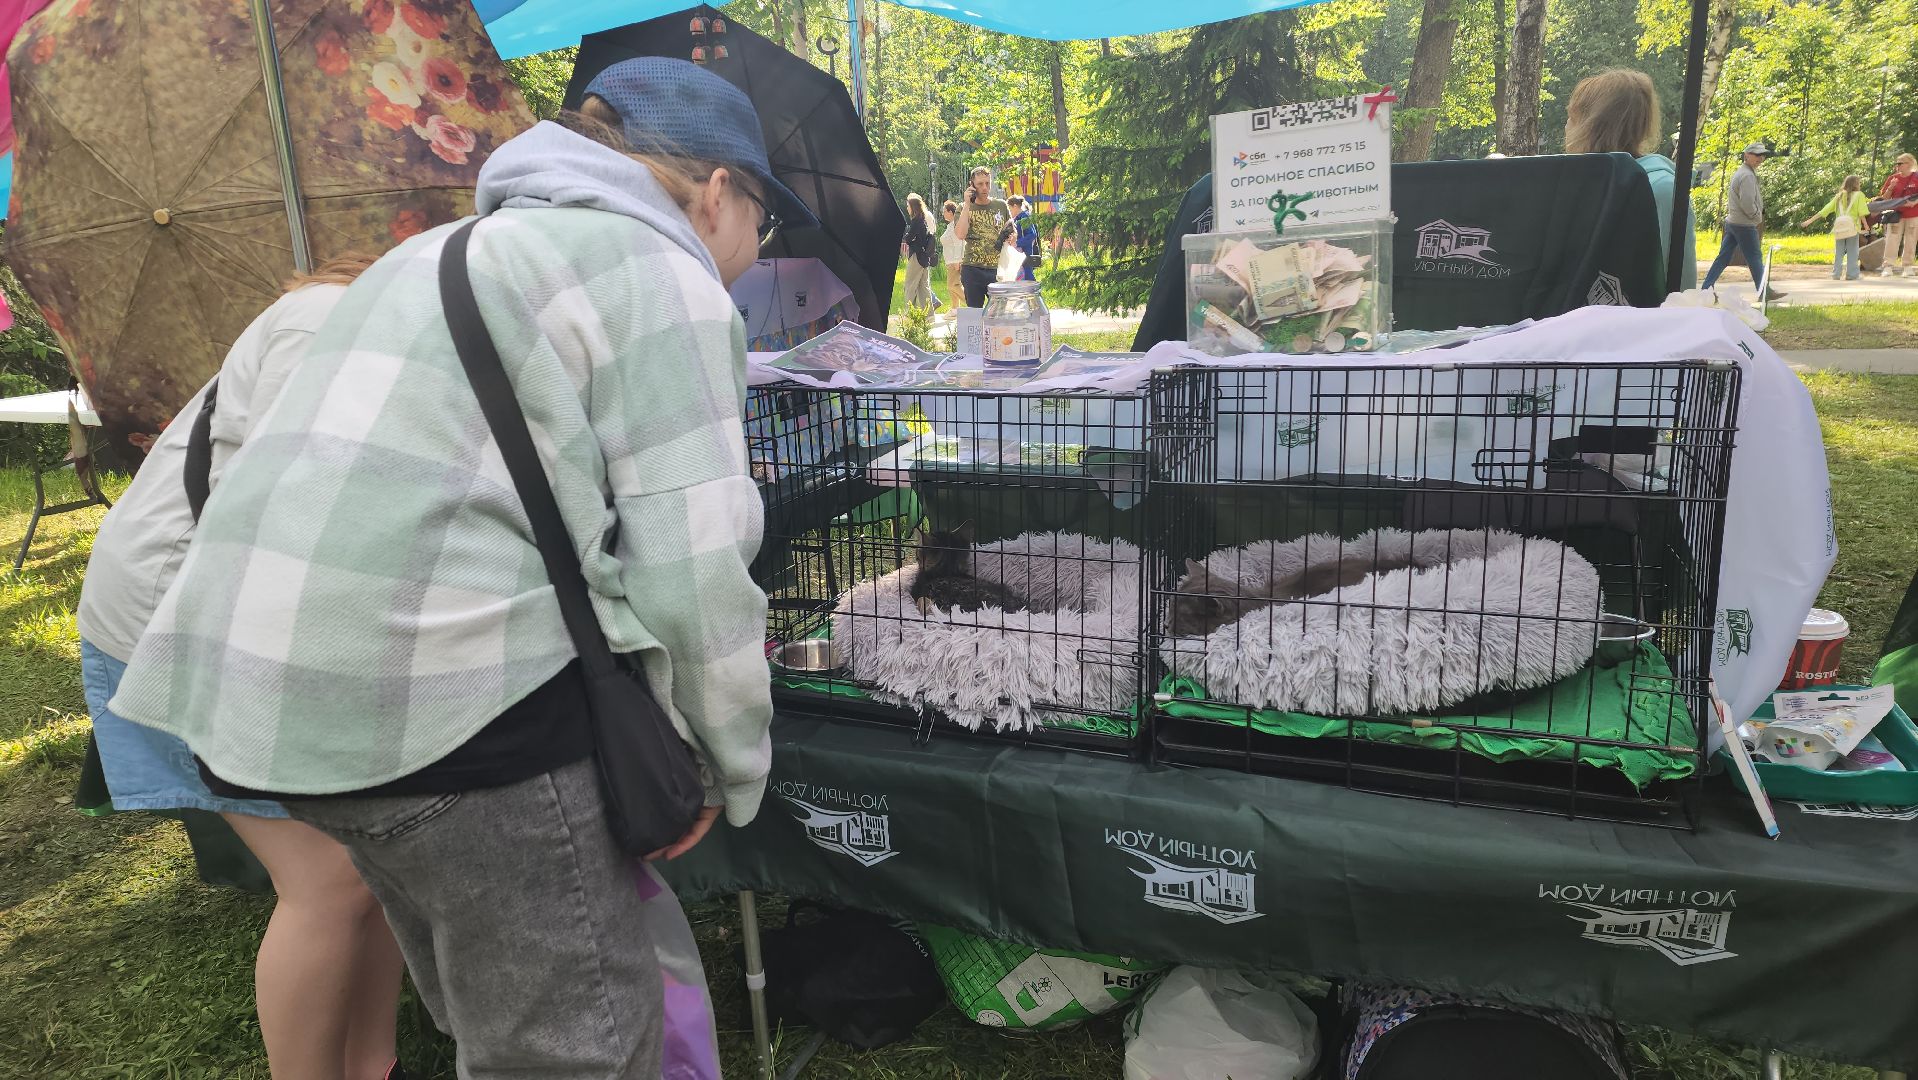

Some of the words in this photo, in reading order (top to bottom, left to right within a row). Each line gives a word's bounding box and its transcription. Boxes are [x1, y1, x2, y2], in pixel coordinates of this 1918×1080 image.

[1284, 151, 1290, 160] 7
[1293, 148, 1313, 159] 968
[1316, 145, 1336, 156] 772
[1338, 143, 1352, 153] 75
[1355, 140, 1366, 151] 15
[1230, 170, 1305, 188] ОГРОМНОЕ
[1308, 161, 1376, 178] СПАСИБО
[1230, 199, 1246, 209] ЗА
[1476, 265, 1511, 279] ДОМ
[769, 778, 808, 798] ДОМ
[810, 785, 889, 811] УЮТНЫЙ
[1104, 827, 1155, 850] ДОМ
[1159, 836, 1257, 869] УЮТНЫЙ
[1538, 883, 1605, 902] ДОМ
